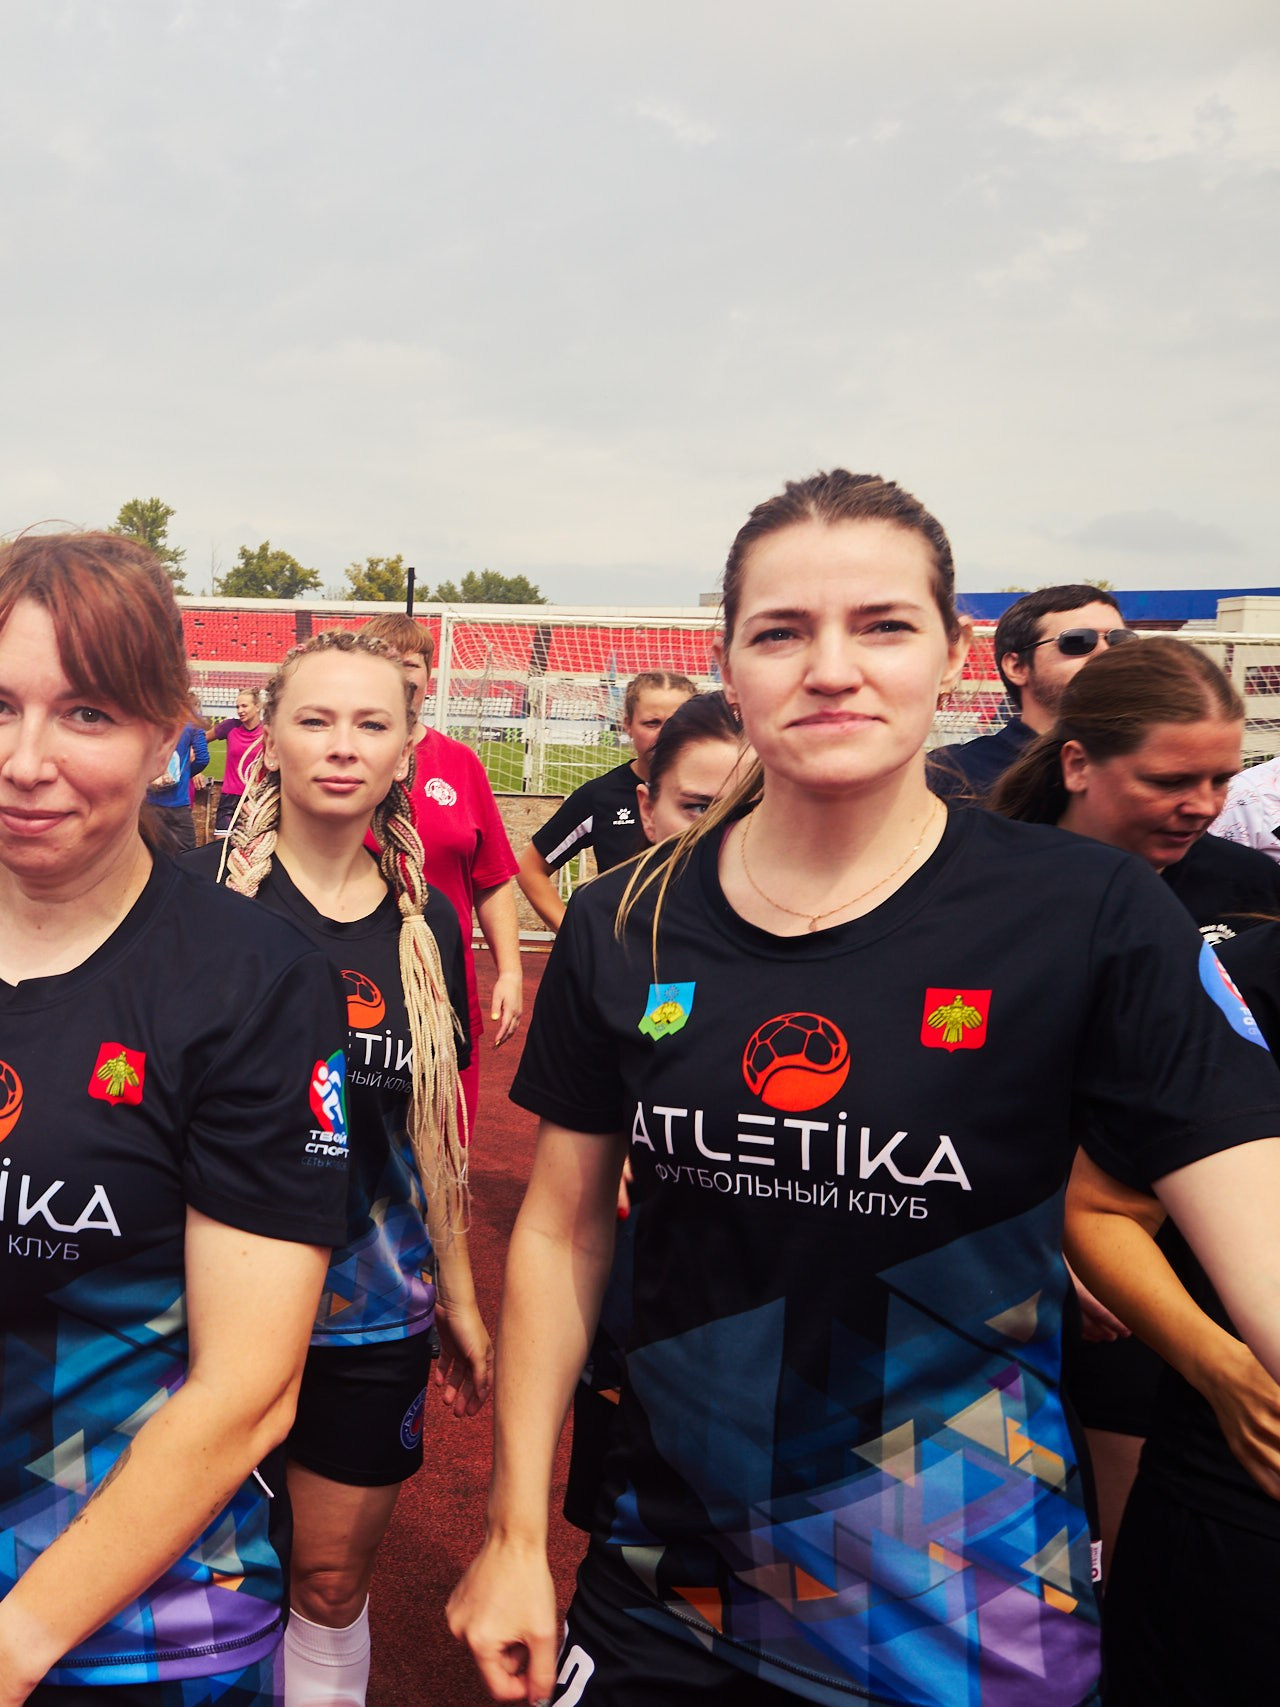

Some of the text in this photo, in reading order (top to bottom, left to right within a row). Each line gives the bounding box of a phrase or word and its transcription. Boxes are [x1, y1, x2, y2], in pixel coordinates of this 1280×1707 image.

[309, 1130, 348, 1145] ТВОЙ
[305, 1143, 350, 1158] СПОРТ
[654, 1163, 929, 1219] ФУТБОЛЬНЫЙ КЛУБ
[8, 1236, 80, 1261] КЛУБ
